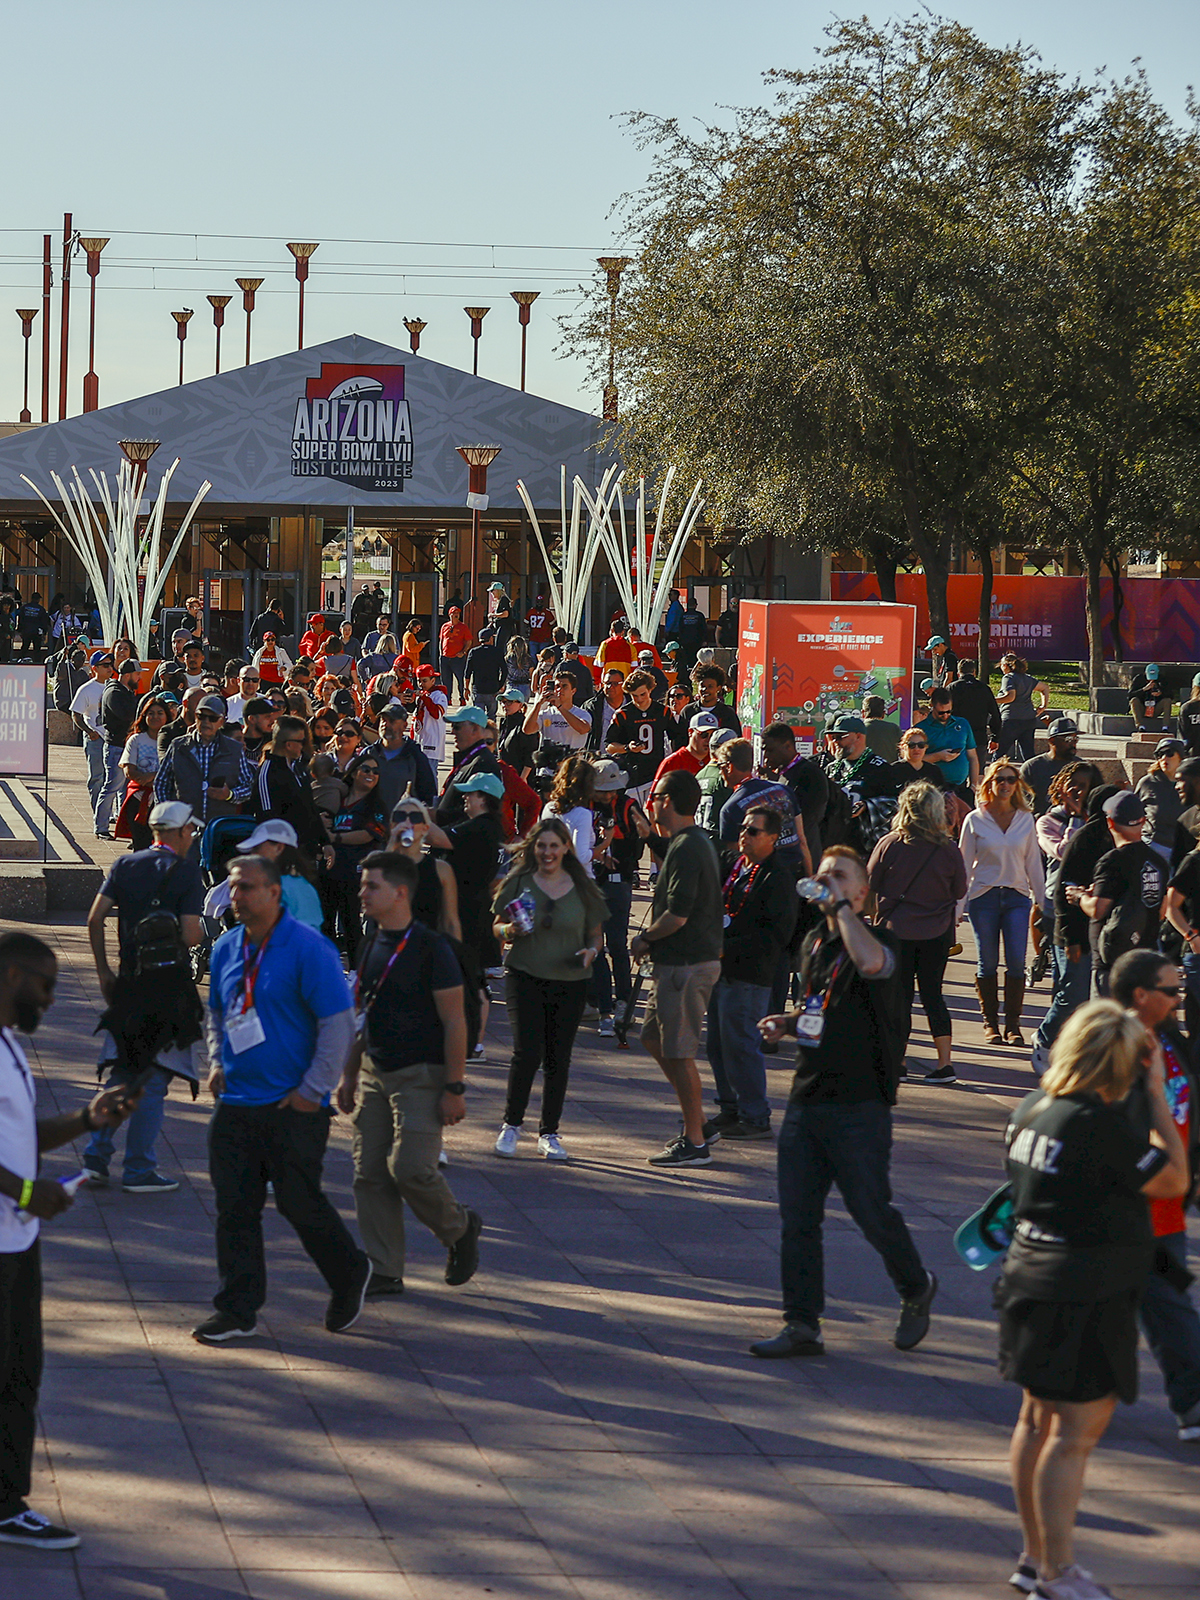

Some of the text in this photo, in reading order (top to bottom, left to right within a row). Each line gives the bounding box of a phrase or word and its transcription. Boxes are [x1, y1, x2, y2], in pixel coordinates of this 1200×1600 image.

[293, 398, 412, 442] ARIZONA
[292, 441, 412, 462] SUPER BOWL LVII
[291, 461, 413, 478] HOST COMMITTEE
[529, 615, 545, 628] 87
[797, 634, 884, 644] EXPERIENCE
[639, 724, 653, 754] 9
